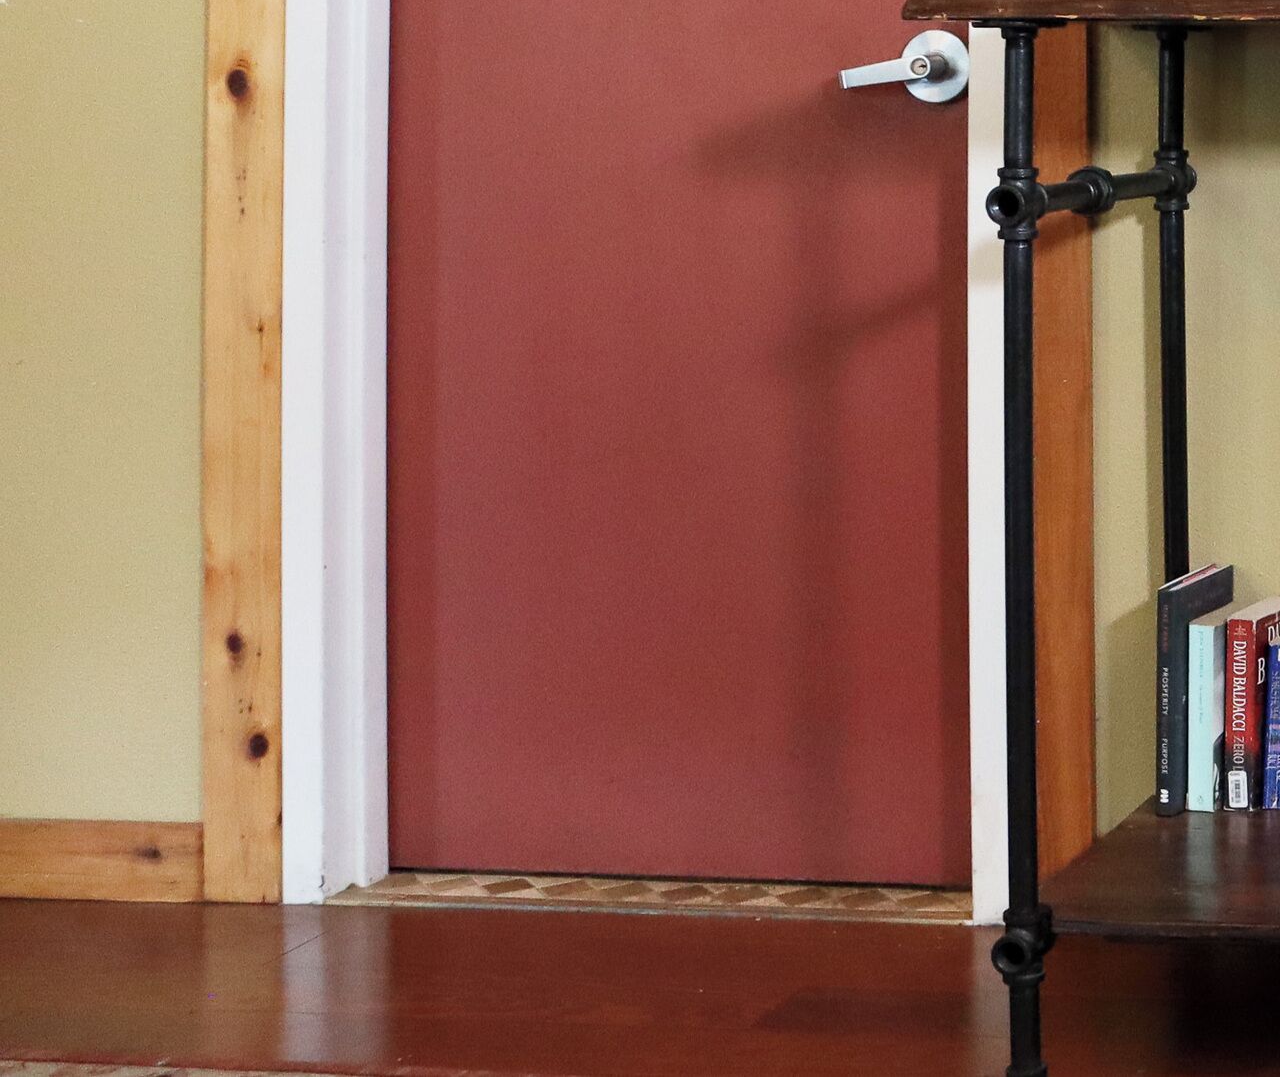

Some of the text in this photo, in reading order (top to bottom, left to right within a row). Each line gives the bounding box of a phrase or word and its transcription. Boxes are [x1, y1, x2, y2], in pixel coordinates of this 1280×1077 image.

[1161, 667, 1169, 715] PROSPERITY
[1232, 641, 1247, 732] DAVID BALDACCI
[1161, 738, 1169, 774] PURPOSE
[1232, 735, 1245, 764] ZERO
